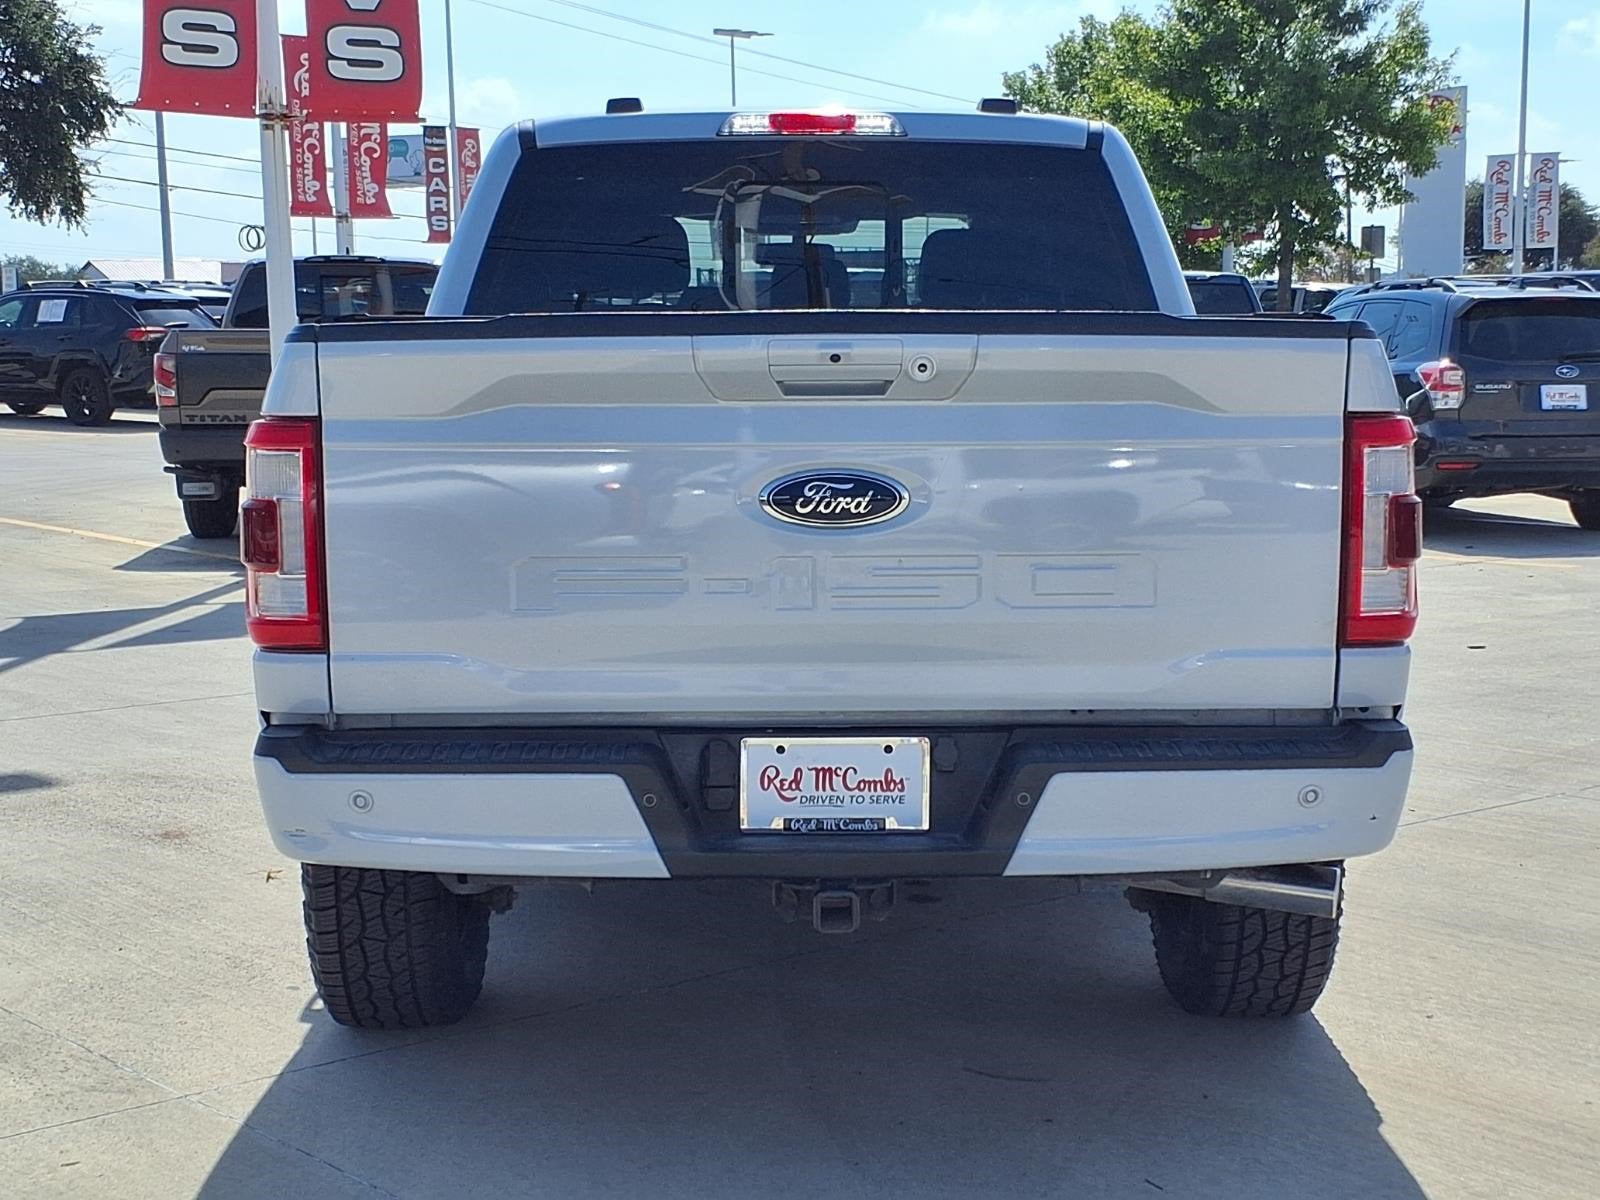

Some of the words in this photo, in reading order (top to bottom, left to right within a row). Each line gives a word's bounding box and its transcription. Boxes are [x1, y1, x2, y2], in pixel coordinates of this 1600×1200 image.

[326, 0, 405, 82] S
[296, 148, 302, 163] TO
[353, 151, 360, 167] TO
[461, 138, 477, 169] Red
[1534, 158, 1555, 184] Red
[296, 167, 306, 202] SERVE
[355, 170, 365, 205] SERVE
[1490, 160, 1511, 186] Red
[428, 157, 448, 232] CARS
[1494, 187, 1510, 245] McCombs
[1536, 186, 1552, 244] McCombs
[184, 414, 247, 422] TITAN
[794, 481, 872, 516] Ford
[508, 552, 1158, 614] F-150
[759, 765, 803, 803] Red
[807, 766, 906, 793] McCombs
[800, 794, 845, 805] DRIVEN
[849, 794, 866, 805] TO
[868, 794, 906, 805] SERVE
[790, 818, 818, 833] Red
[822, 818, 879, 831] McCombs
